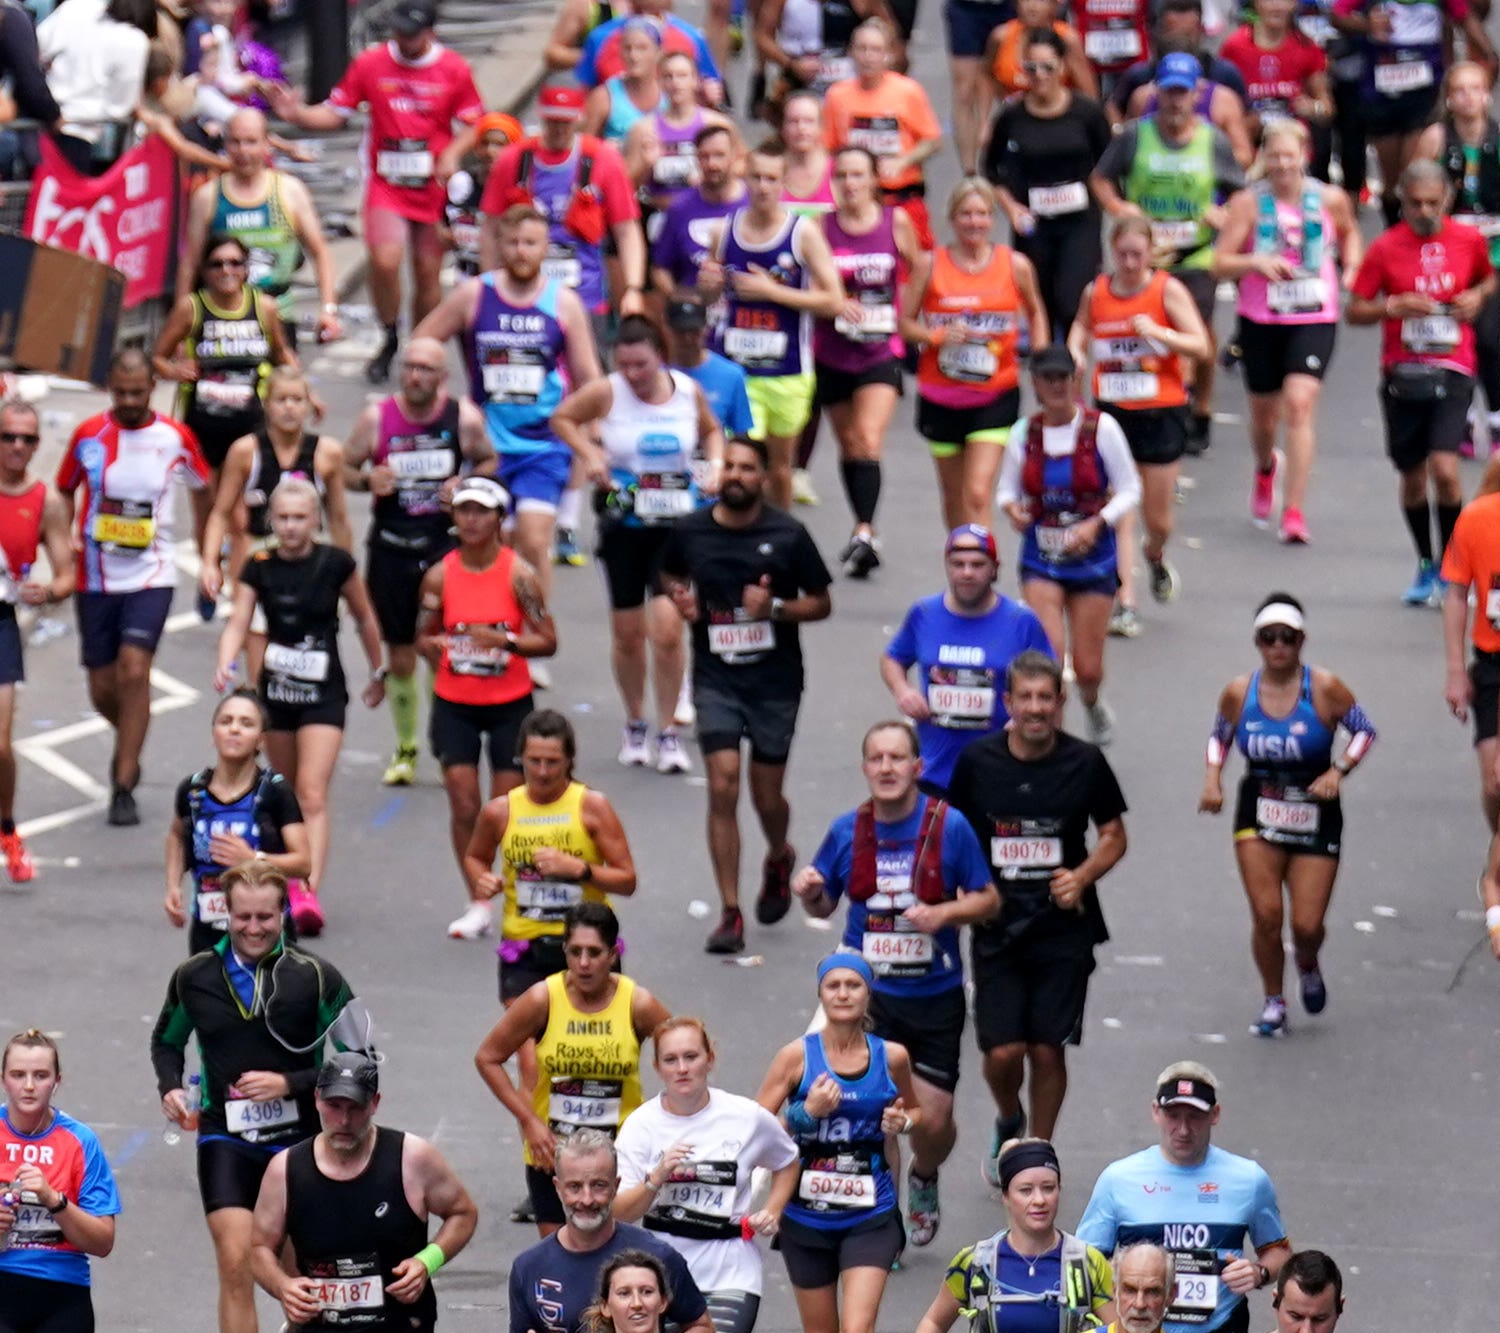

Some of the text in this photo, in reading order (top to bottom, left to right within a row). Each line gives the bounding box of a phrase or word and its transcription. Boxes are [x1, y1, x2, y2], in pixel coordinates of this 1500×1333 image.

[1248, 733, 1300, 759] USA
[567, 1019, 612, 1036] ANGIE
[544, 1060, 633, 1076] Sunshine
[241, 1102, 284, 1119] 4309
[5, 1143, 55, 1165] TOR
[669, 1185, 723, 1205] 19174
[1163, 1223, 1209, 1250] NICO
[318, 1283, 372, 1303] 47187
